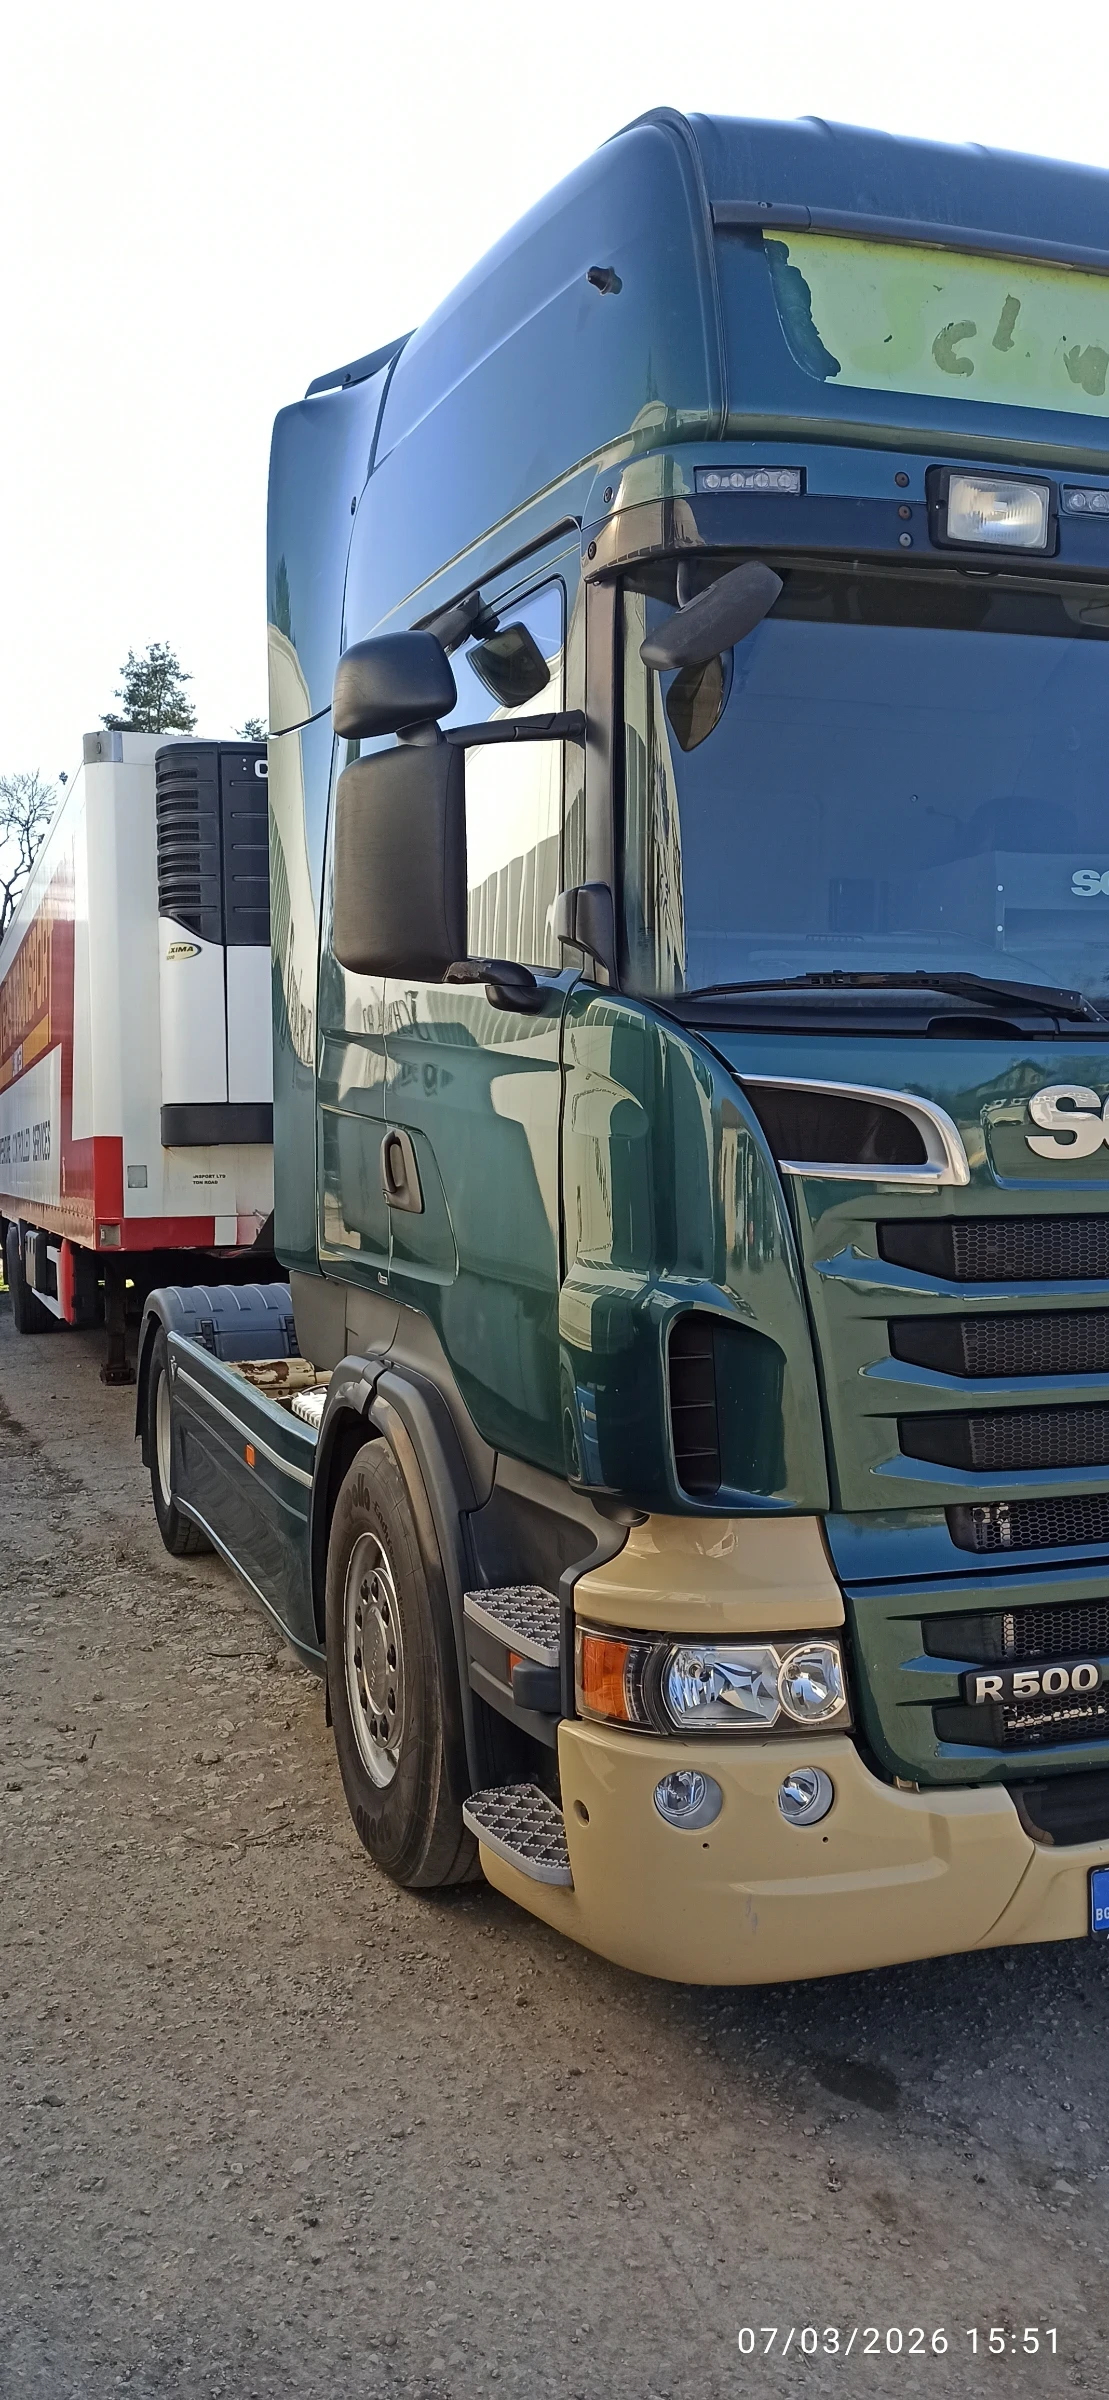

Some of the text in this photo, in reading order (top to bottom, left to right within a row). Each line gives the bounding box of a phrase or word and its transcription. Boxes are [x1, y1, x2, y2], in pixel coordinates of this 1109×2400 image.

[1071, 870, 1109, 896] S
[168, 946, 194, 954] XIMA
[1025, 1084, 1109, 1159] S
[976, 1664, 1098, 1703] R 500
